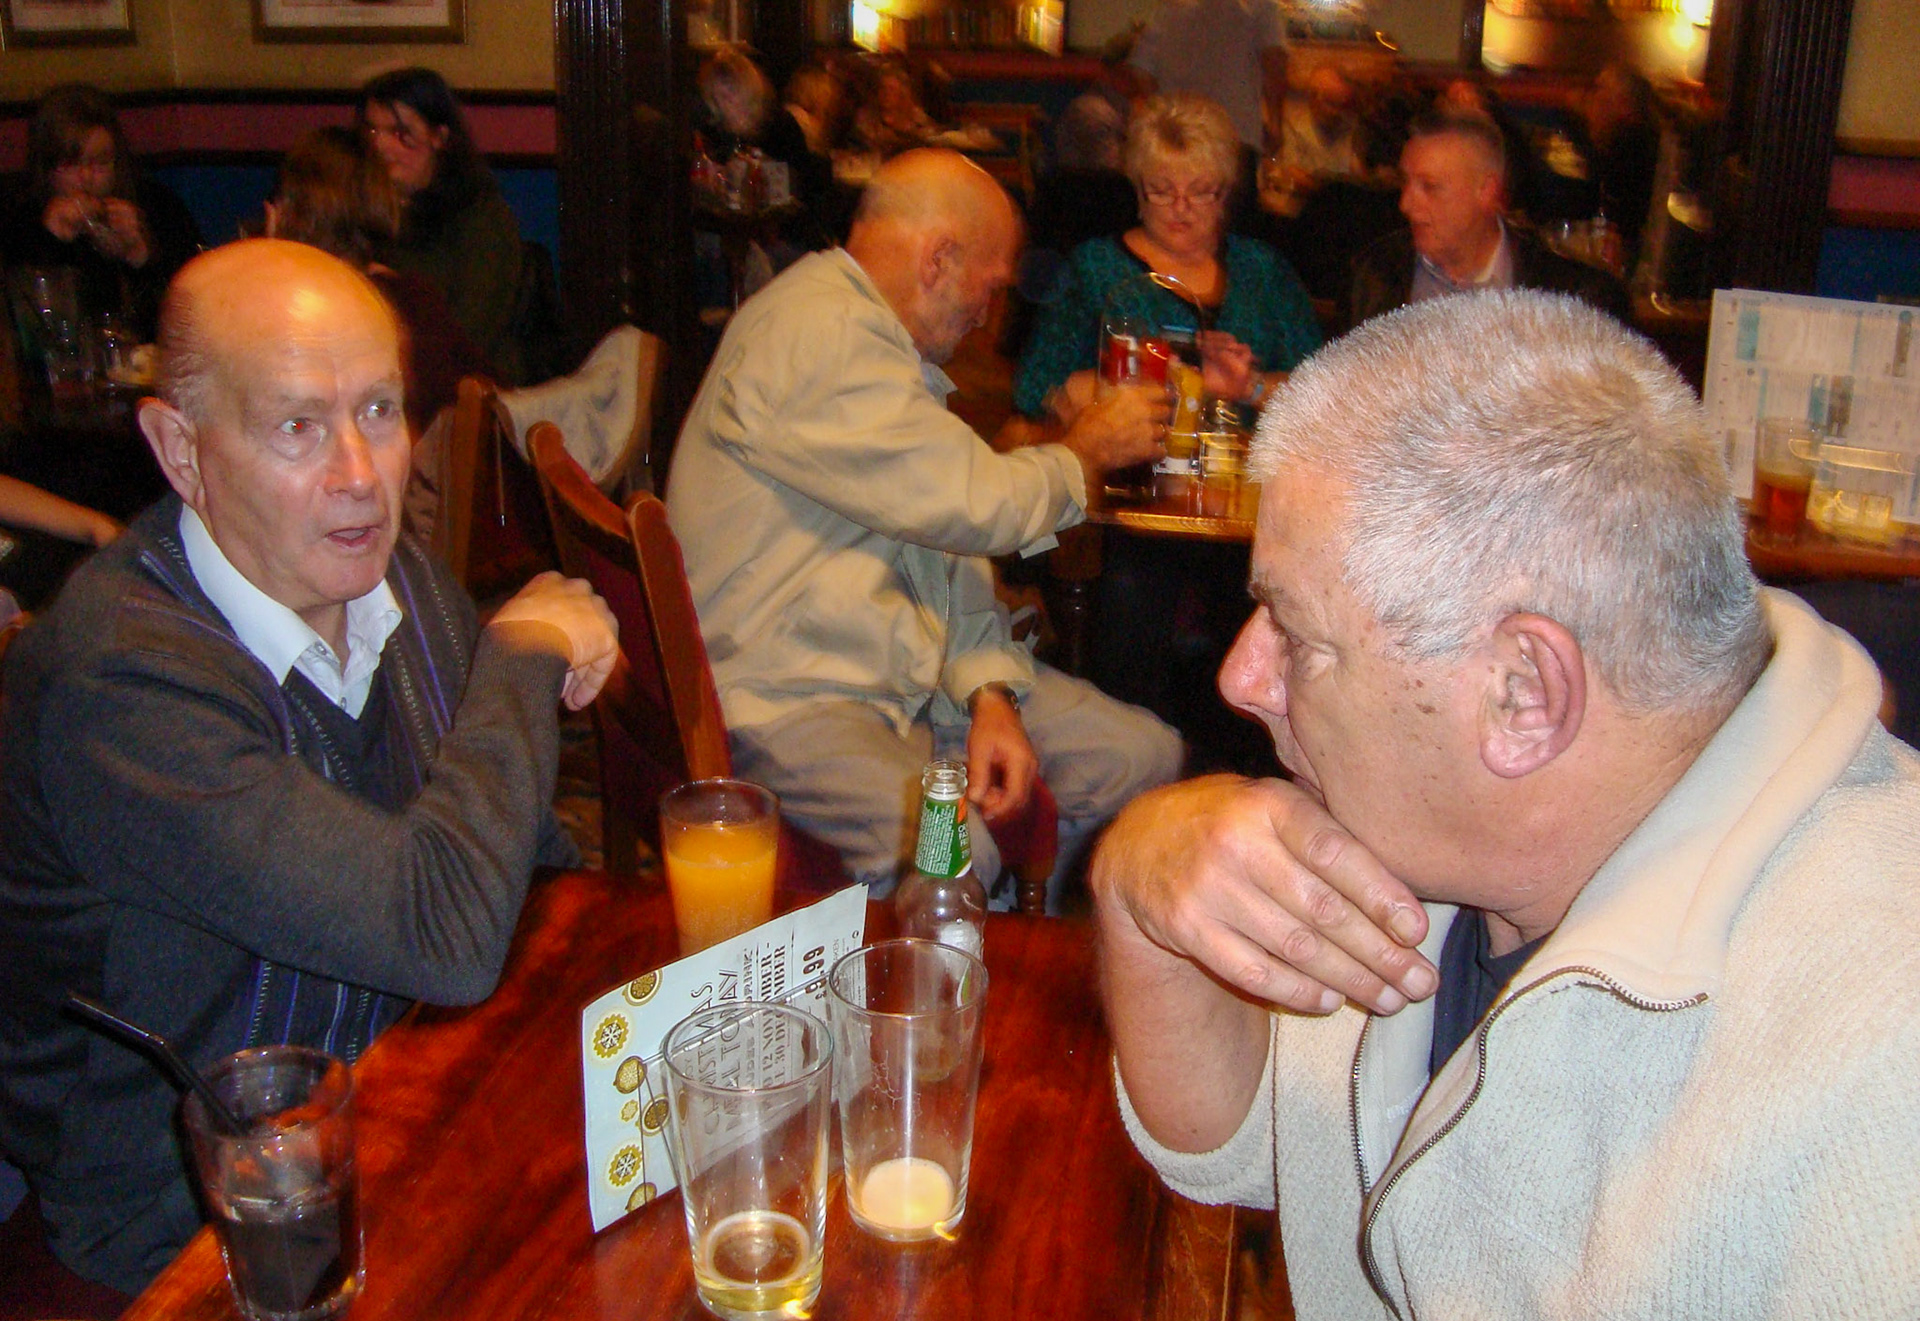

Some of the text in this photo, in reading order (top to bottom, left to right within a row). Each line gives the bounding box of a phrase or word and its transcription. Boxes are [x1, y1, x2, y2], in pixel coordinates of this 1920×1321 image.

[803, 945, 827, 1000] £9.99
[774, 945, 786, 1041] DECMBER
[762, 1053, 773, 1071] 12
[775, 1045, 786, 1064] 30
